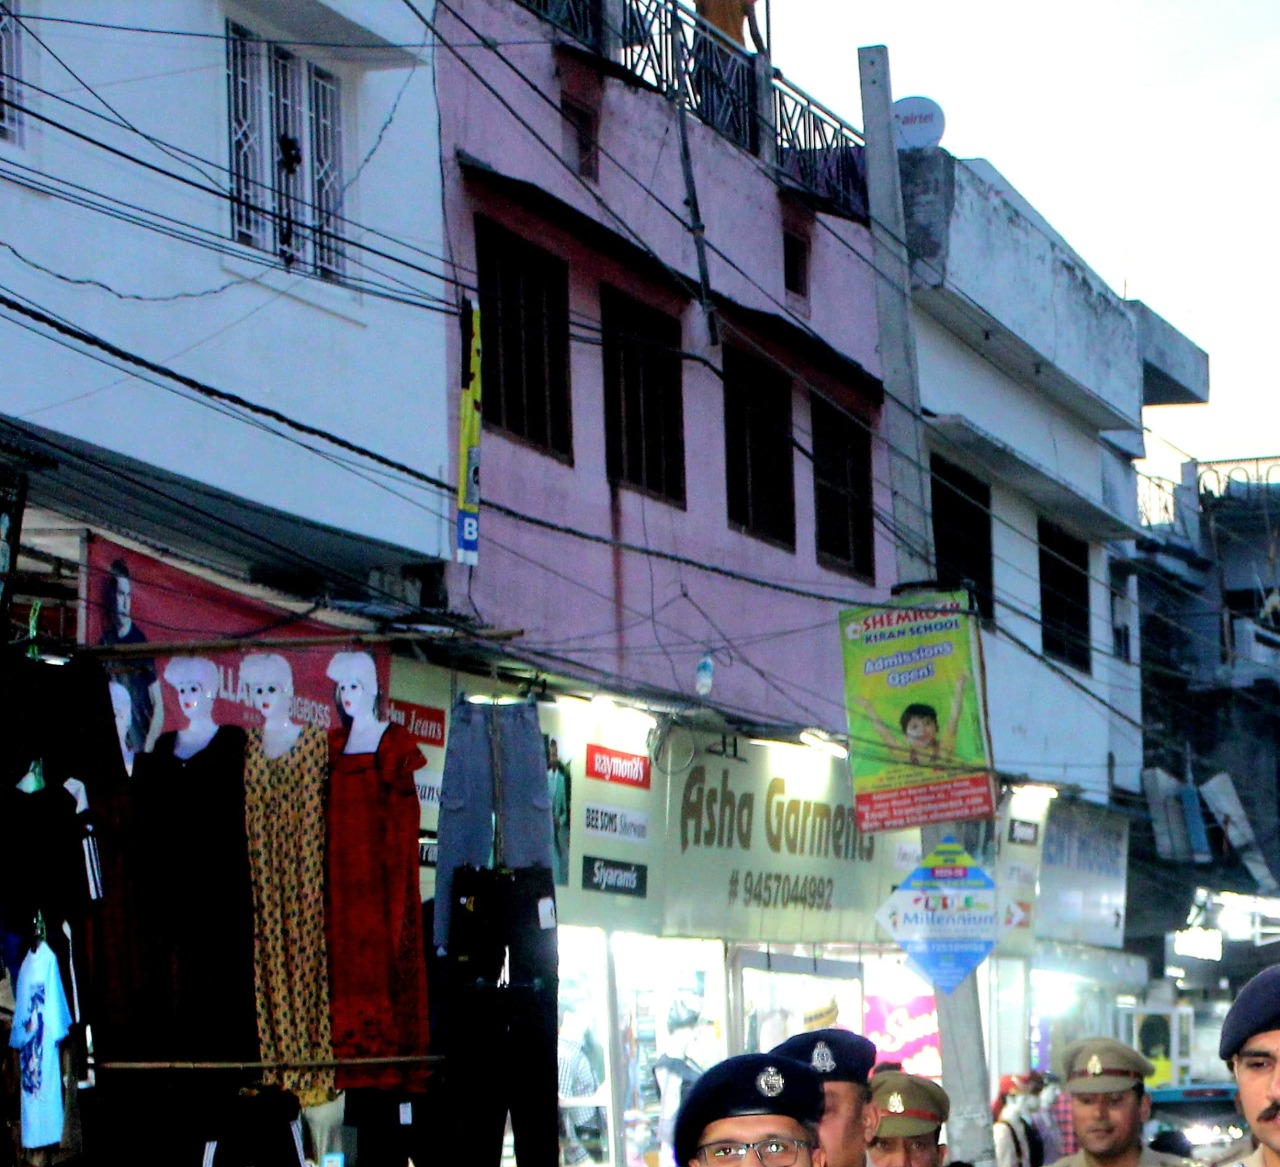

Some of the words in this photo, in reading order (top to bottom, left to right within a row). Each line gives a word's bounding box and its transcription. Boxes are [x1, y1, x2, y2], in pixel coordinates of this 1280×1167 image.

[464, 518, 478, 541] B
[865, 628, 906, 645] KIRAN
[909, 618, 960, 638] SCHOOL
[864, 641, 954, 676] Admissions
[681, 765, 755, 855] Asha
